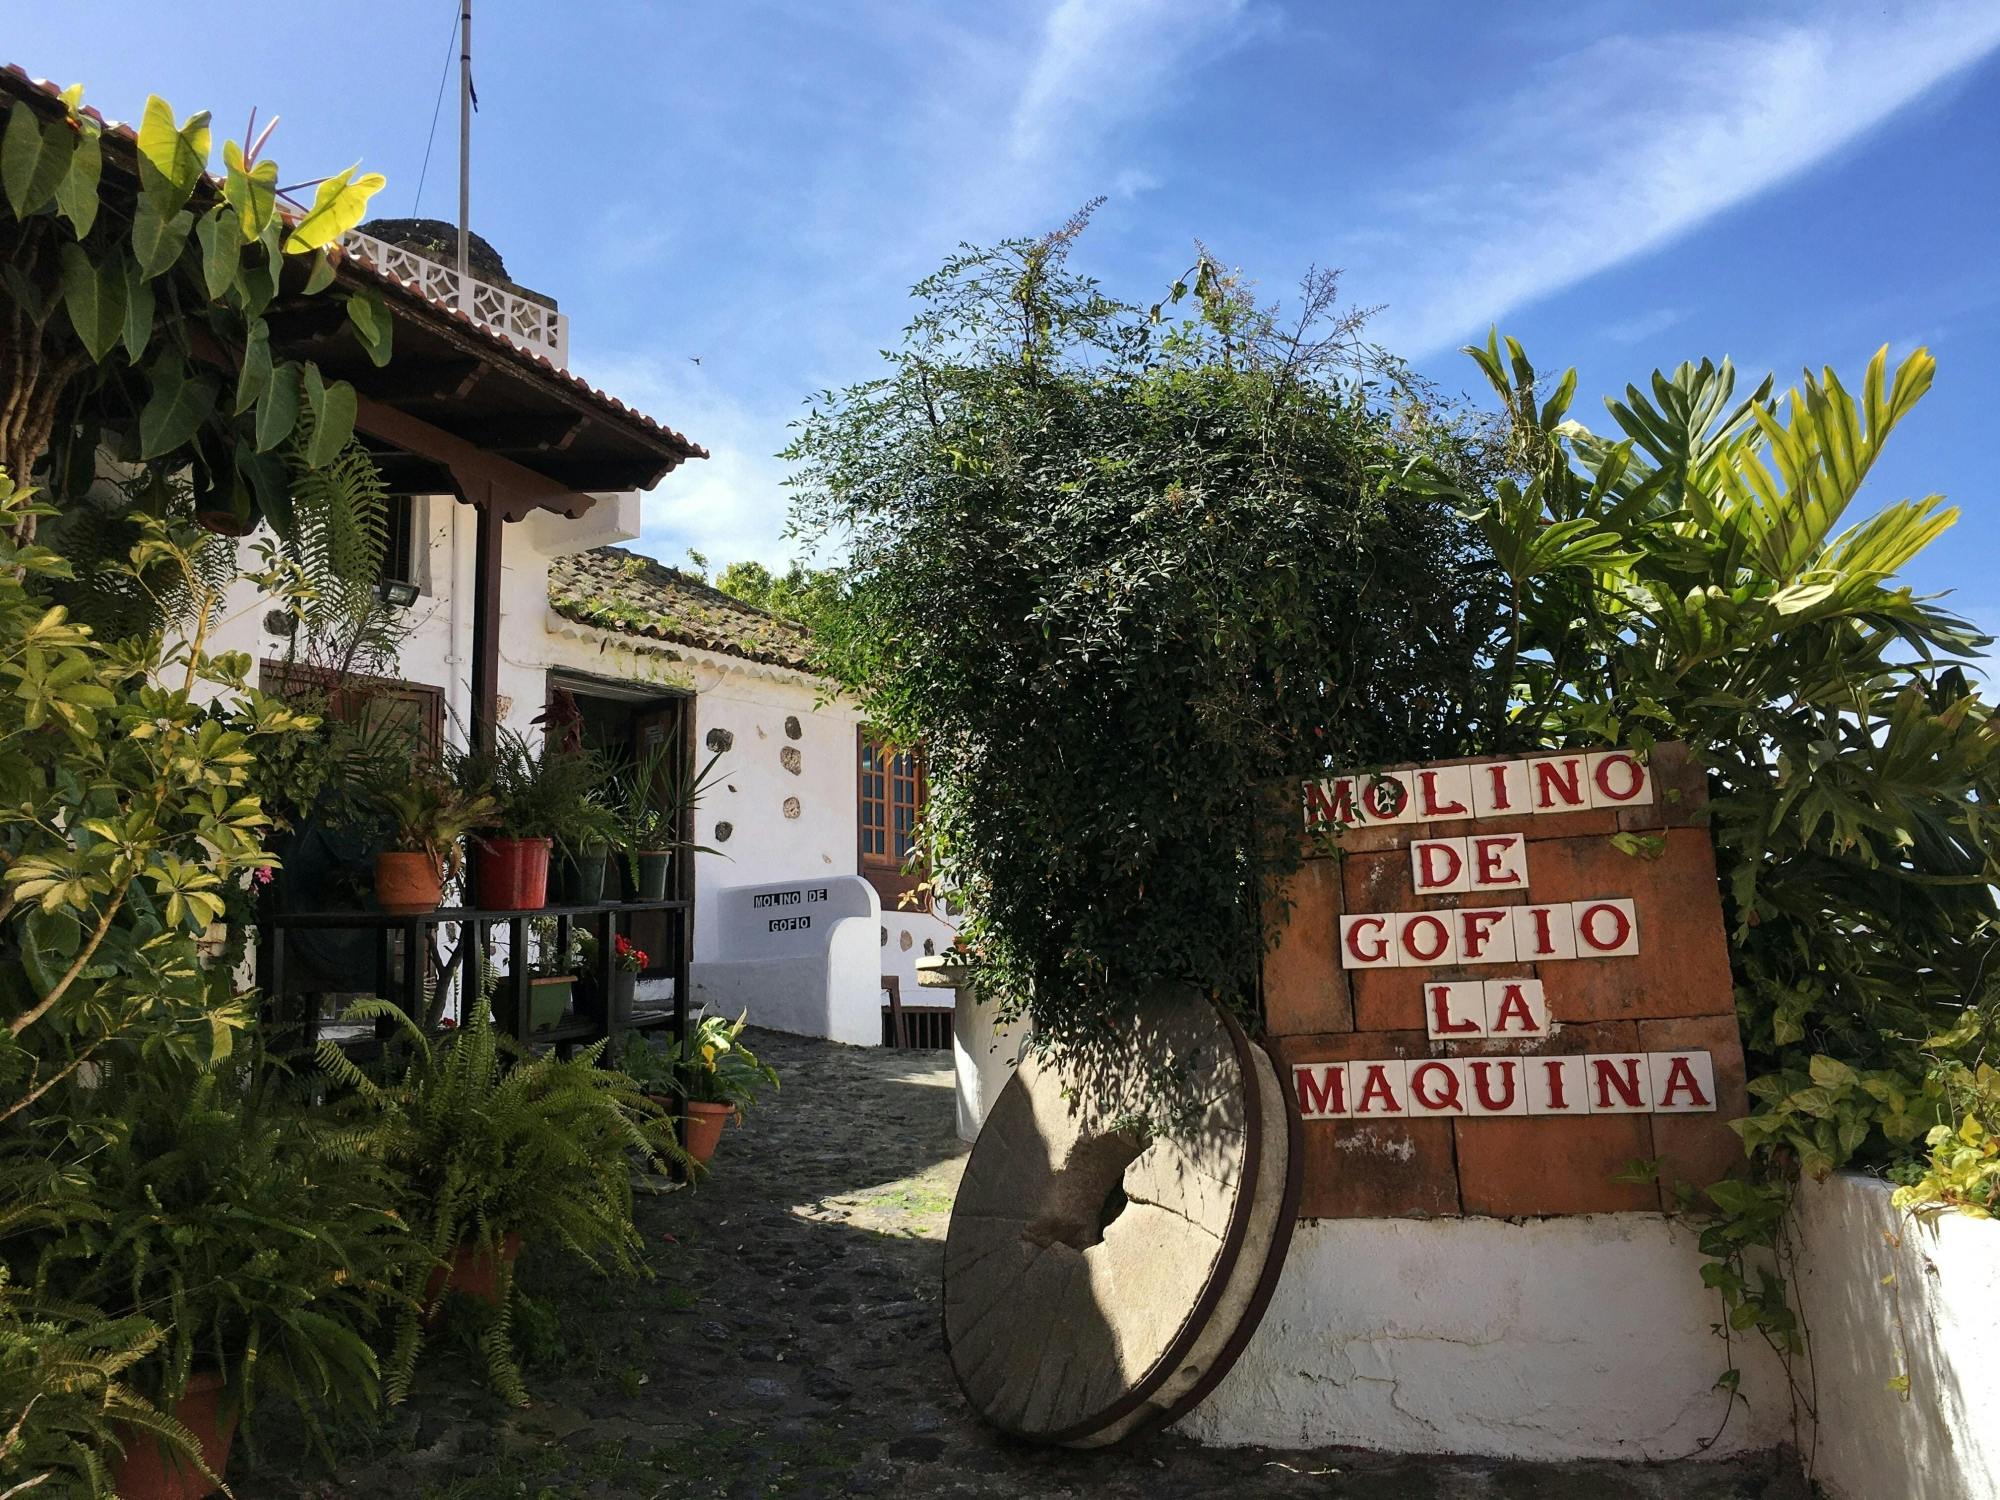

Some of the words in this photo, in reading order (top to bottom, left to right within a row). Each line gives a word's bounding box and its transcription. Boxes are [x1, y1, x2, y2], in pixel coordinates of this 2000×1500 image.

[1304, 754, 1646, 825] MOLINO
[1416, 838, 1521, 888] DE
[755, 892, 800, 908] MOLINO
[808, 889, 827, 903] DE
[771, 918, 809, 932] GOFIO
[1346, 904, 1632, 963] GOFIO
[1428, 985, 1541, 1034] LA
[1295, 1056, 1712, 1115] MAQUINA
